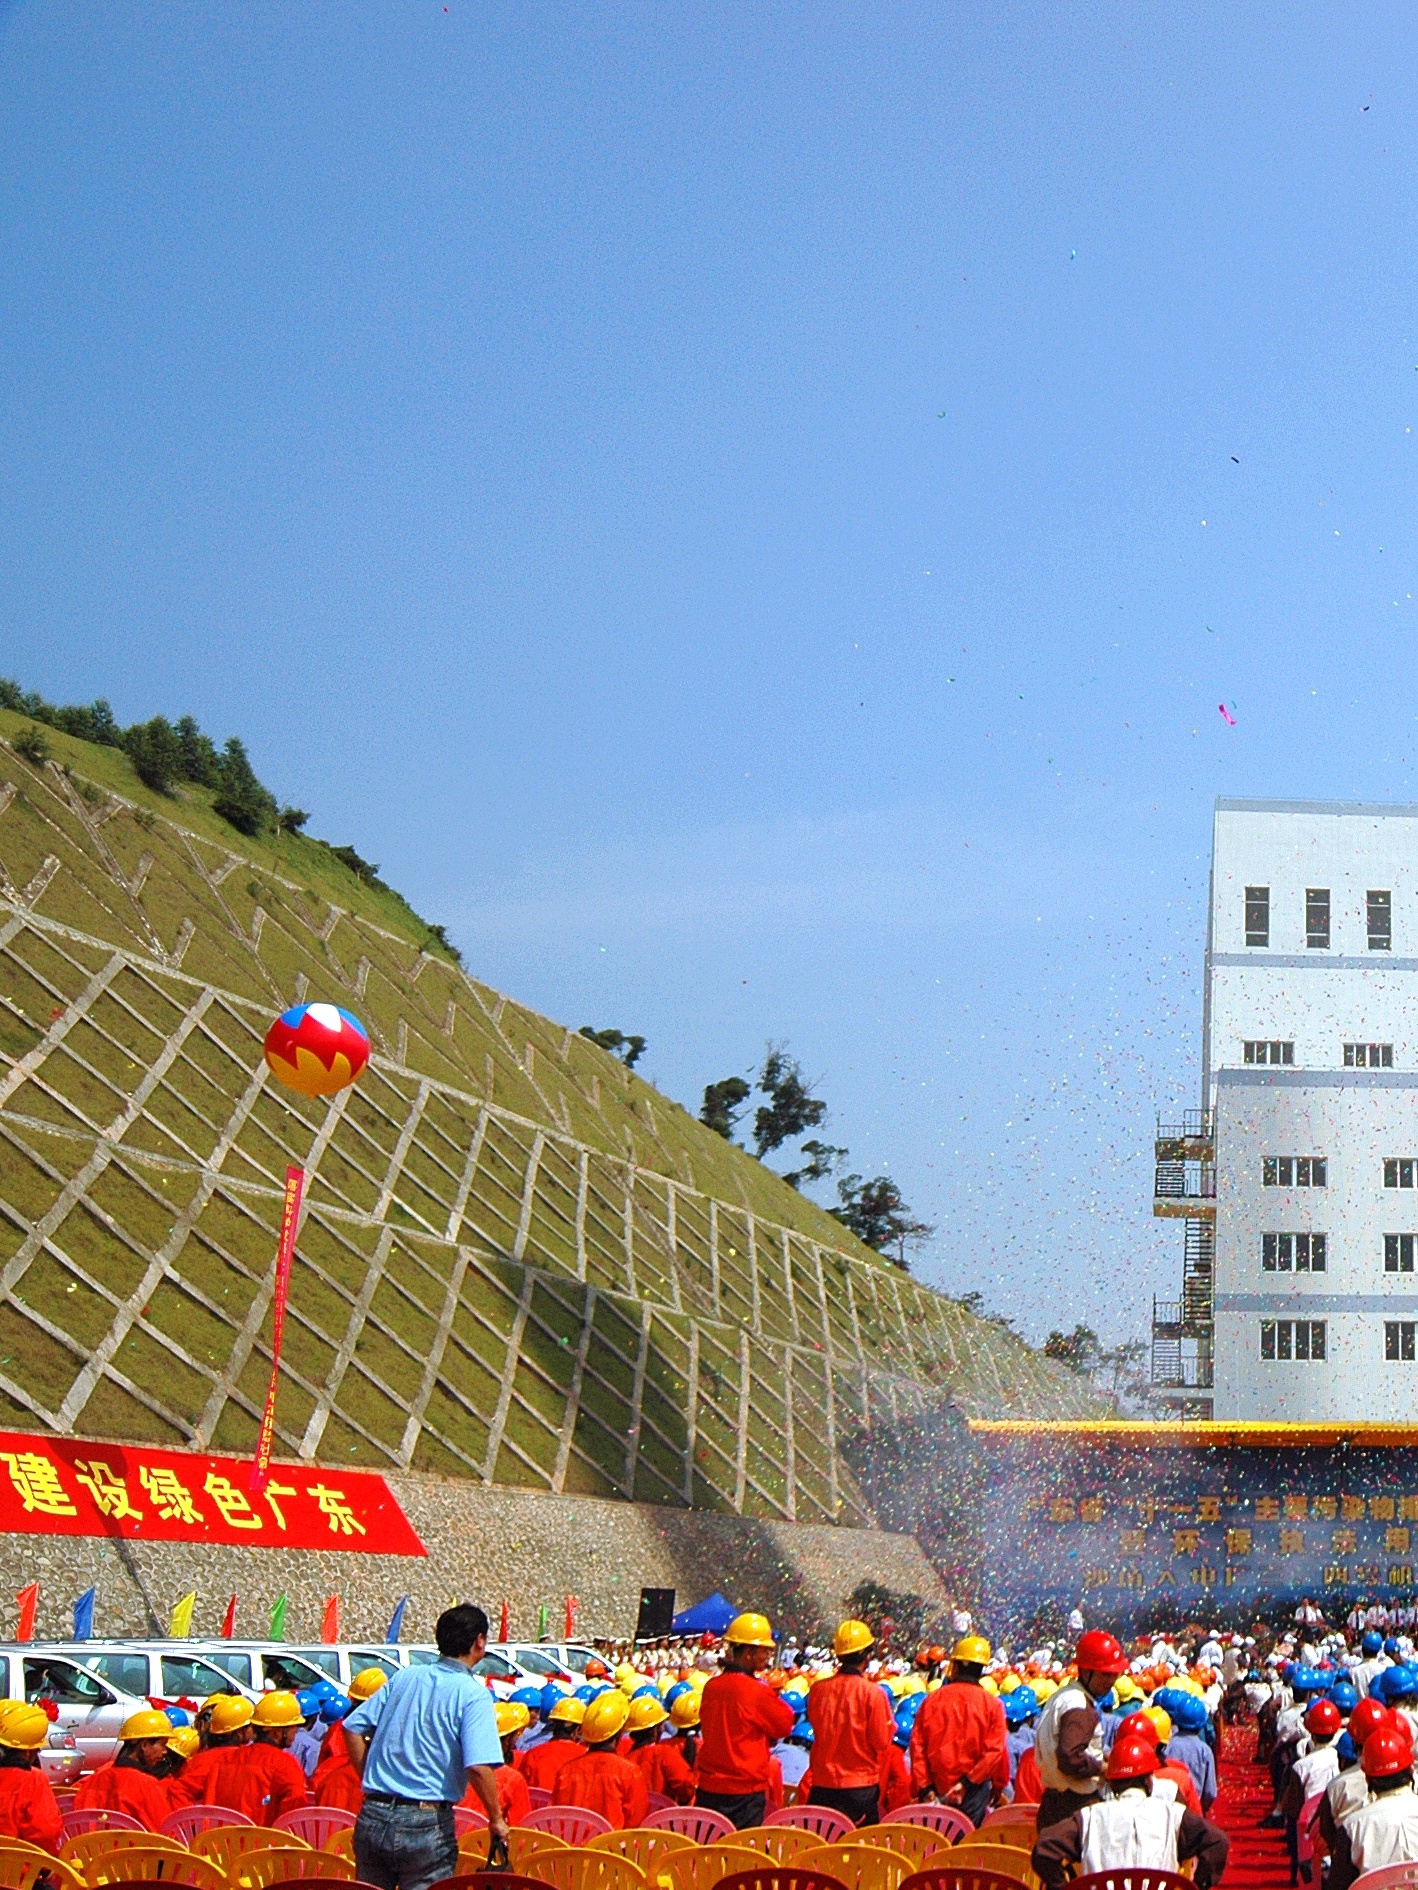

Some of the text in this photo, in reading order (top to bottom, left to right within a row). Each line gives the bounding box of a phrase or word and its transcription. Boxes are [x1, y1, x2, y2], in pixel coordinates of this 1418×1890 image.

[0, 1451, 367, 1537] 建设绿色广东
